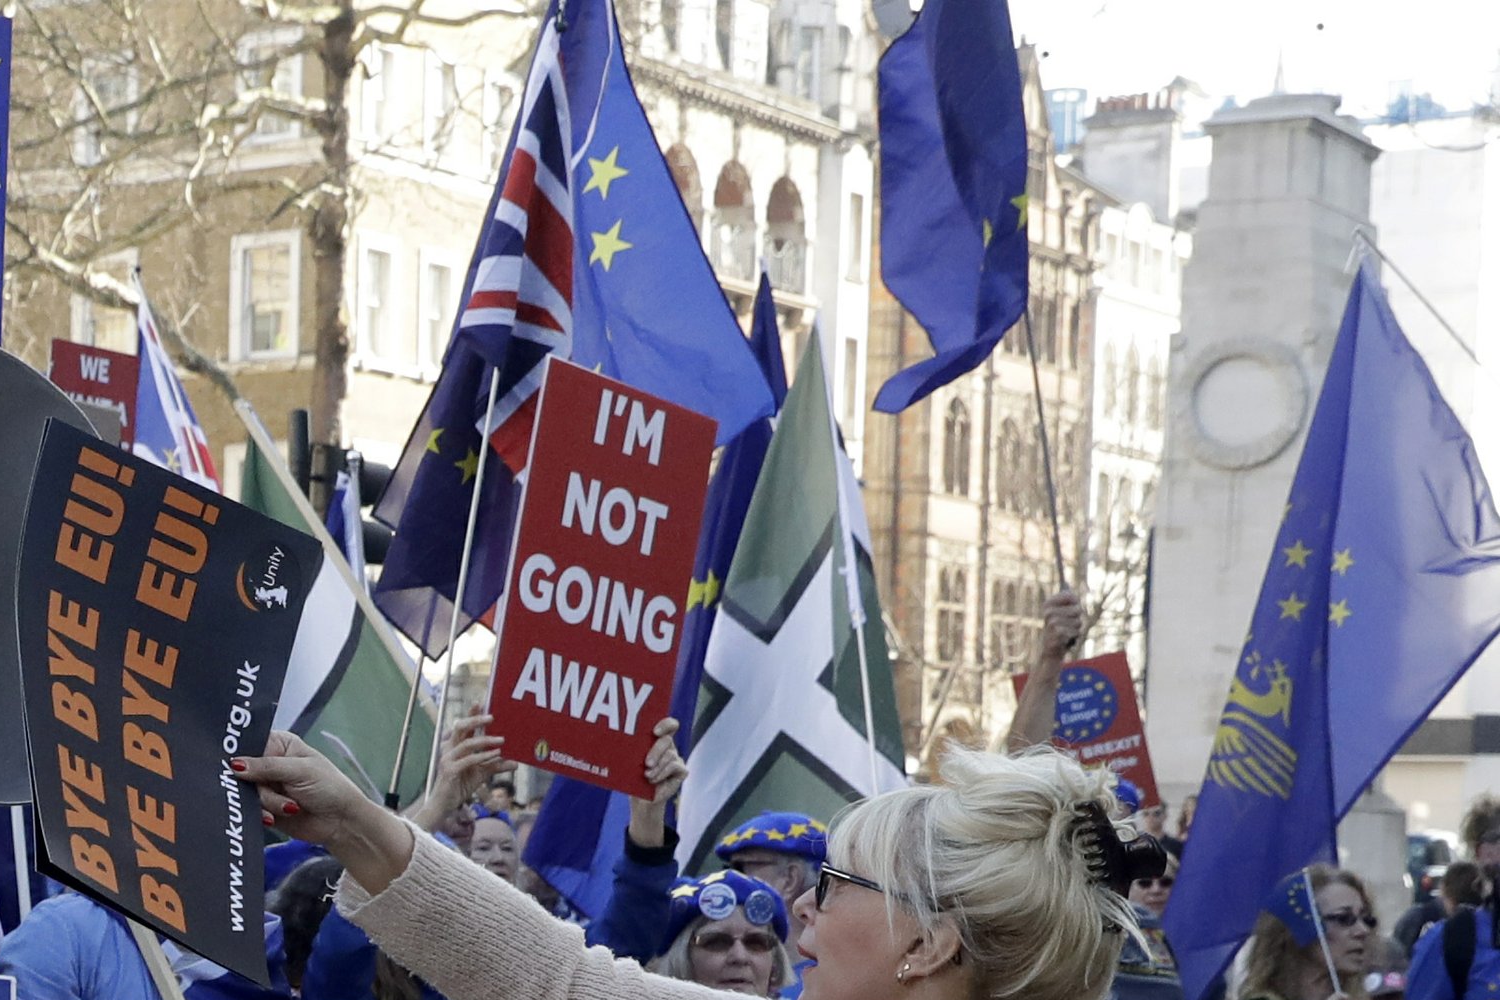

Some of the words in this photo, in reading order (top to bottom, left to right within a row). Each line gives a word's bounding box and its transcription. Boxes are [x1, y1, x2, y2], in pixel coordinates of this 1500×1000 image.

[80, 354, 110, 384] WE
[593, 388, 666, 466] I'M
[54, 446, 136, 585] EU!
[135, 485, 221, 623] EU!
[263, 546, 285, 587] Unity
[561, 471, 670, 556] NOT
[518, 552, 677, 654] GOING
[47, 589, 100, 742] BYE
[121, 628, 180, 780] BYE
[511, 647, 654, 737] AWAY
[58, 744, 120, 895] BYE
[126, 785, 187, 934] BYE
